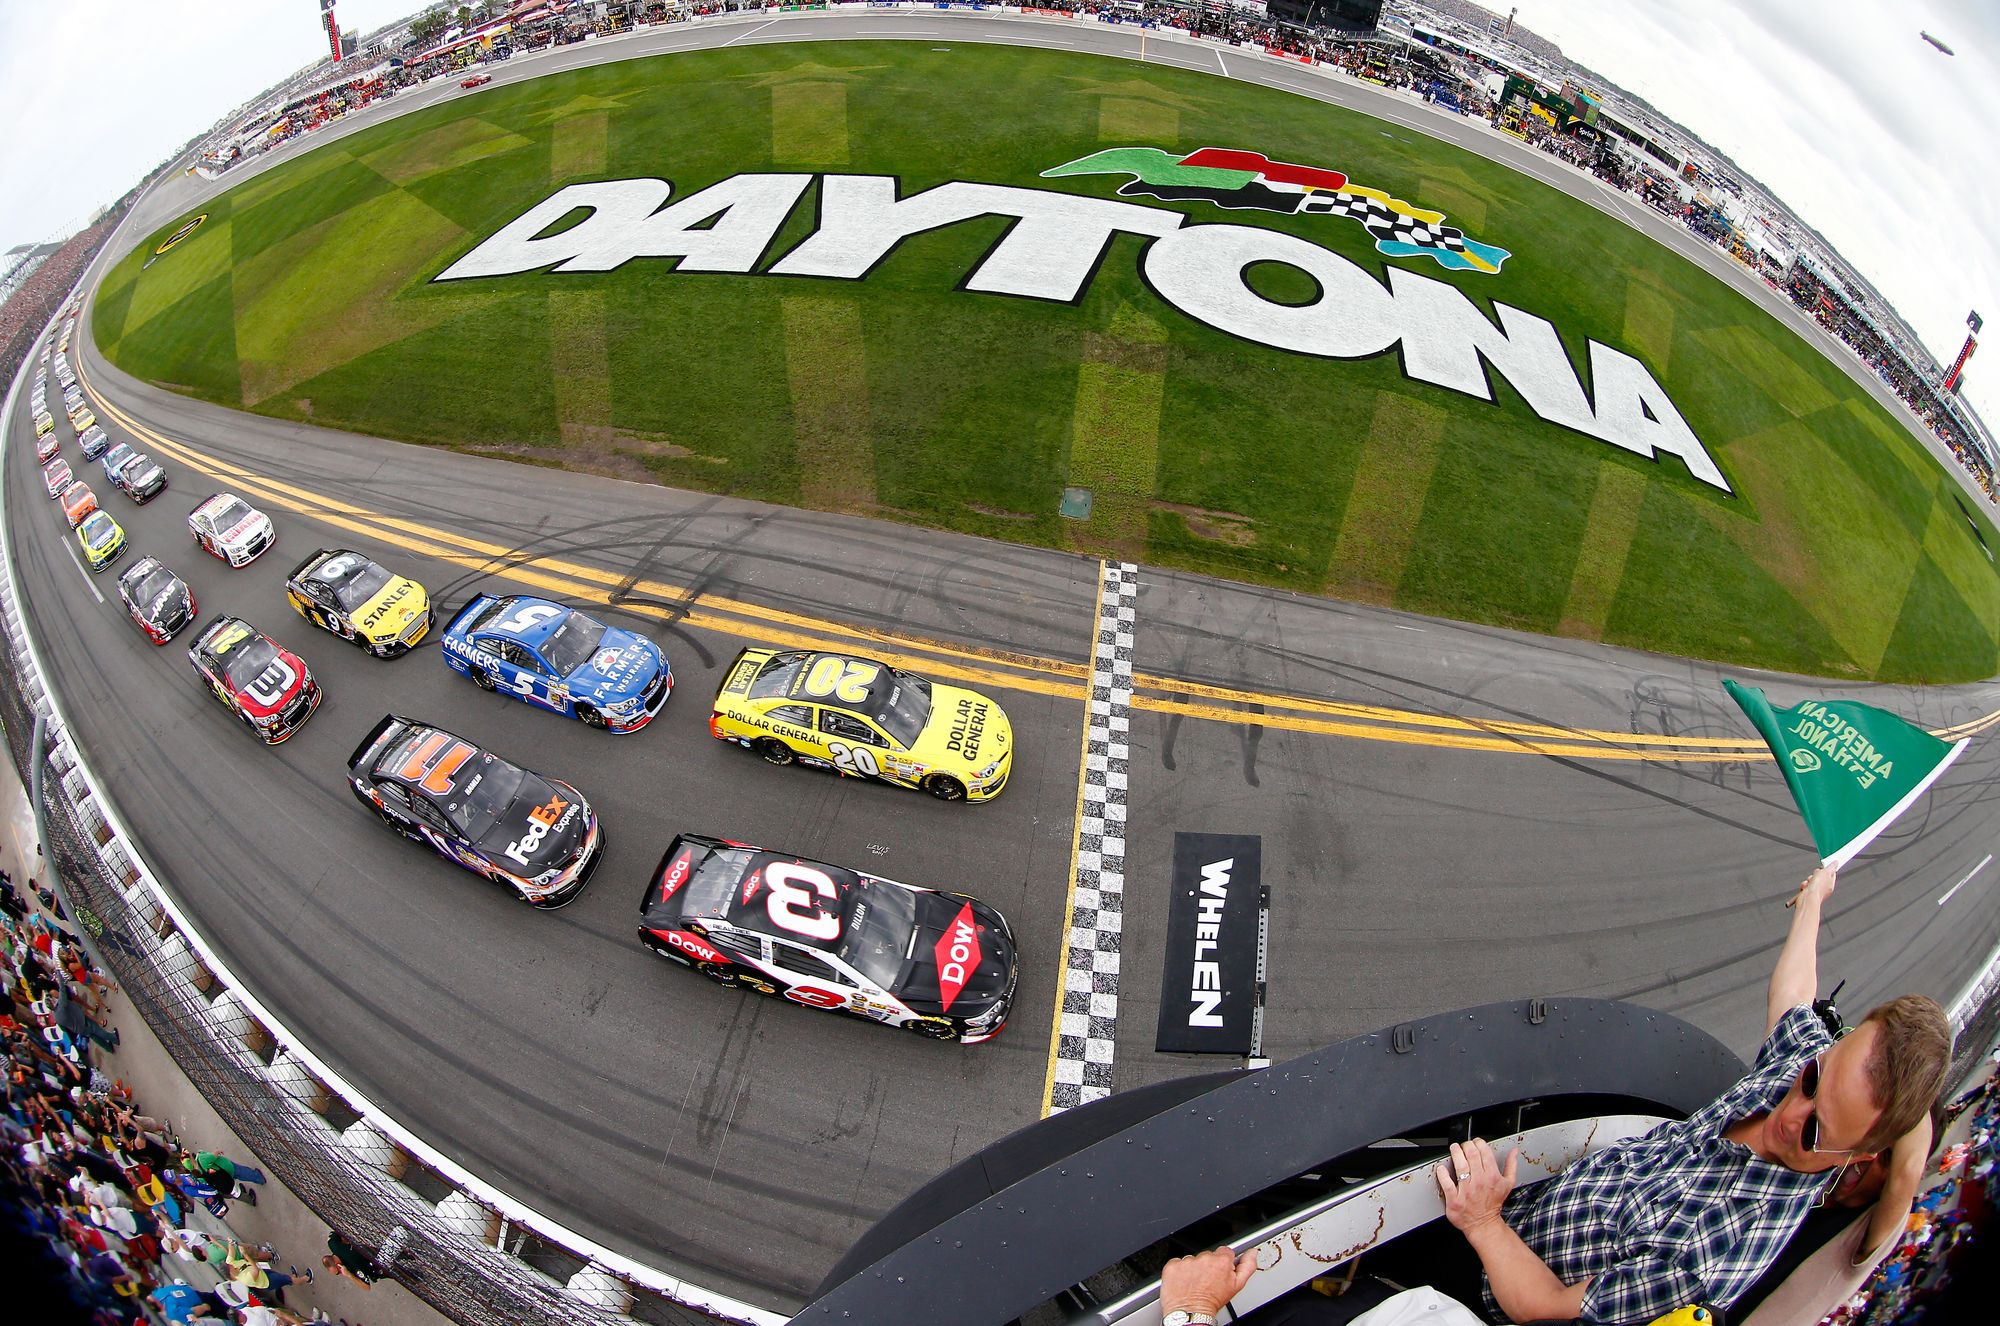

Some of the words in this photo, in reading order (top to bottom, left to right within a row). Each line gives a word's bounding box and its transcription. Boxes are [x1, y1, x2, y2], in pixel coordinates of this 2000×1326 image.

[1200, 34, 1231, 45] CATERPILLAR
[1579, 127, 1595, 140] Sprint
[429, 173, 1734, 496] DAYTONA
[150, 578, 177, 623] HAAS
[363, 582, 414, 629] STANLEY
[328, 613, 340, 631] 9
[499, 605, 562, 633] 5
[444, 635, 501, 673] FARMERS
[593, 636, 649, 700] FARMERS
[513, 671, 536, 695] 5
[615, 650, 653, 693] INSURANCE
[729, 662, 748, 690] GENERAL
[740, 664, 757, 690] DOLLAR
[805, 656, 880, 704] 20
[727, 710, 770, 731] DOLLAR
[772, 724, 823, 746] GENERAL
[946, 699, 973, 752] DOLLAR
[963, 703, 989, 761] GENERAL
[827, 742, 880, 776] 20
[464, 773, 483, 796] HAMLIN
[504, 795, 569, 867] FedEx
[553, 804, 581, 834] Express
[764, 861, 841, 942] 3
[851, 902, 867, 931] DILLON
[712, 923, 751, 936] REALTREE
[1188, 857, 1235, 1028] WHELEN
[785, 984, 847, 1010] 3
[886, 1008, 900, 1016] 3M
